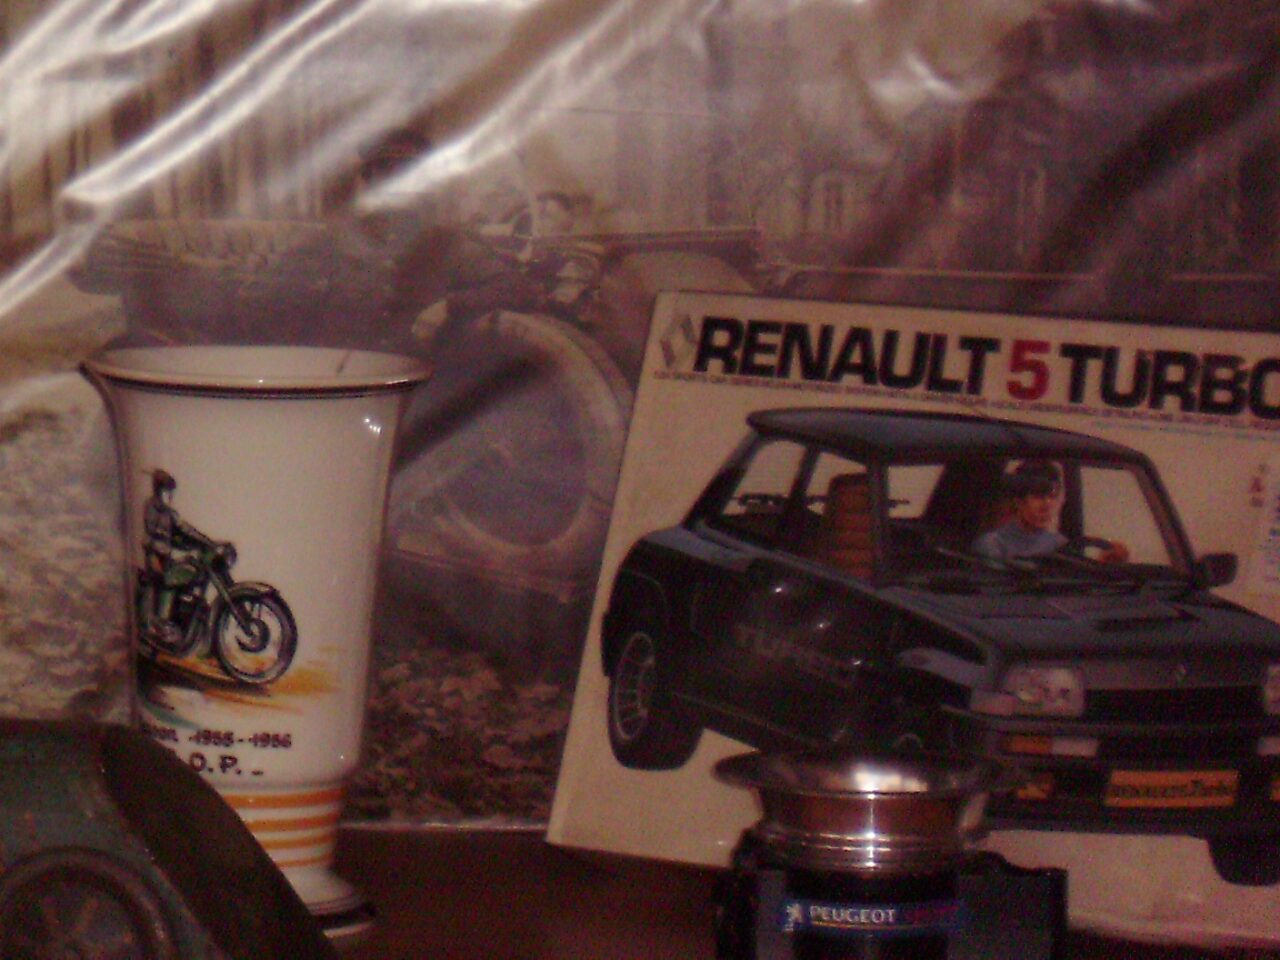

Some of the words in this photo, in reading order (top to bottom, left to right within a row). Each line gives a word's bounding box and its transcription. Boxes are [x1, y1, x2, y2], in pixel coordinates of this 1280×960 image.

[693, 317, 999, 394] RENAULT
[1007, 340, 1050, 400] 5
[809, 904, 897, 923] PEUGEOT
